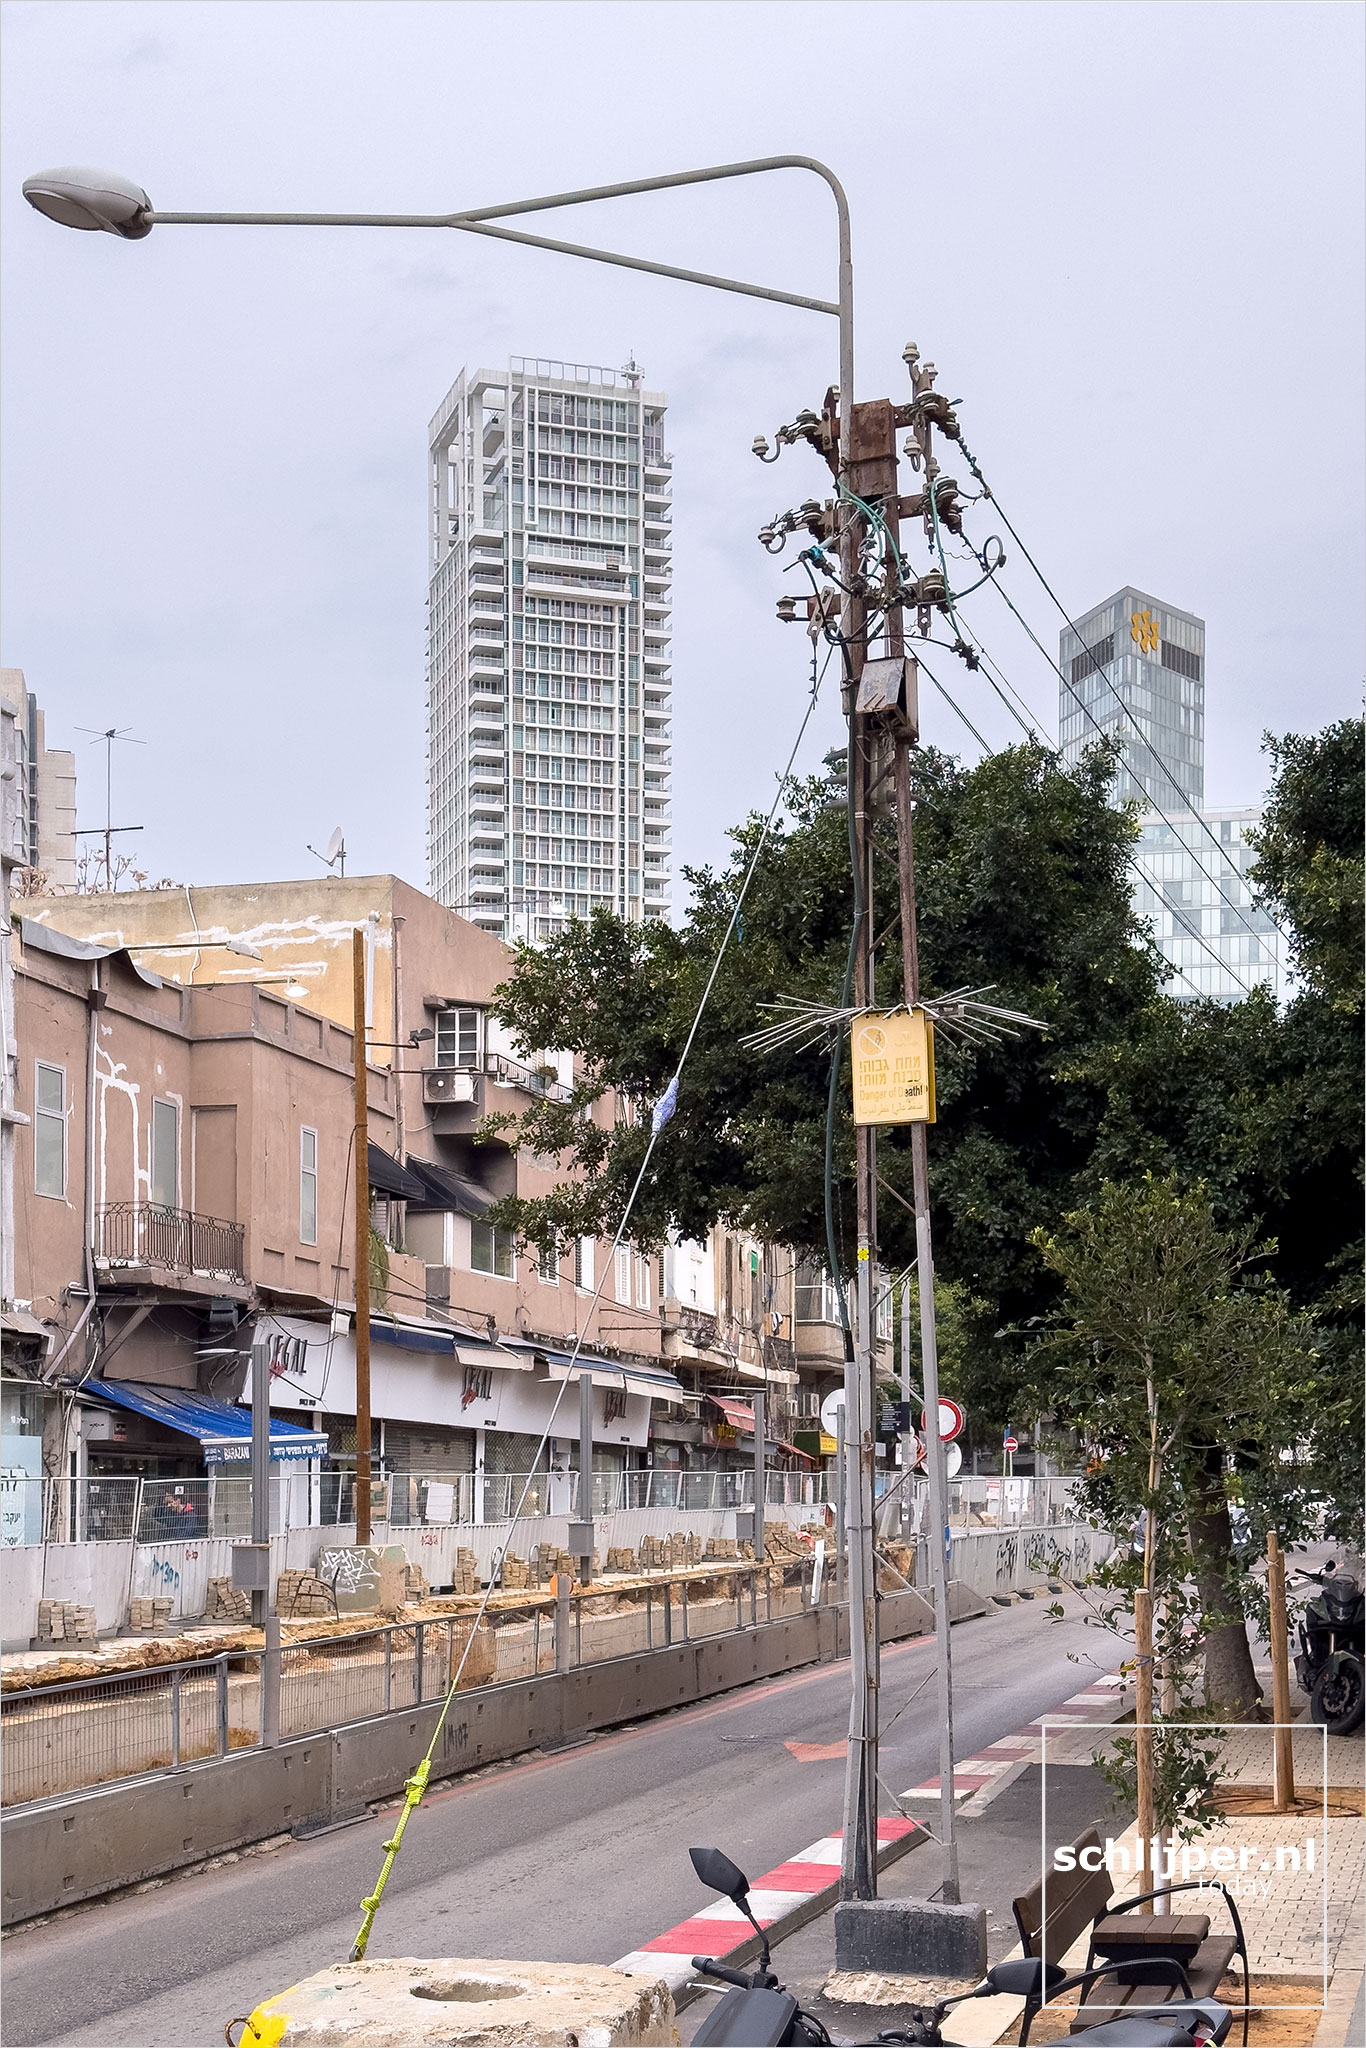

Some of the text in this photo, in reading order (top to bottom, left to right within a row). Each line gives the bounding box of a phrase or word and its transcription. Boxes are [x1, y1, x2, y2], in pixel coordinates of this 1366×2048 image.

[859, 1055, 921, 1073] מתח גבוה!
[859, 1070, 922, 1087] סכנת מוות!
[860, 1085, 923, 1102] Danger of Death!
